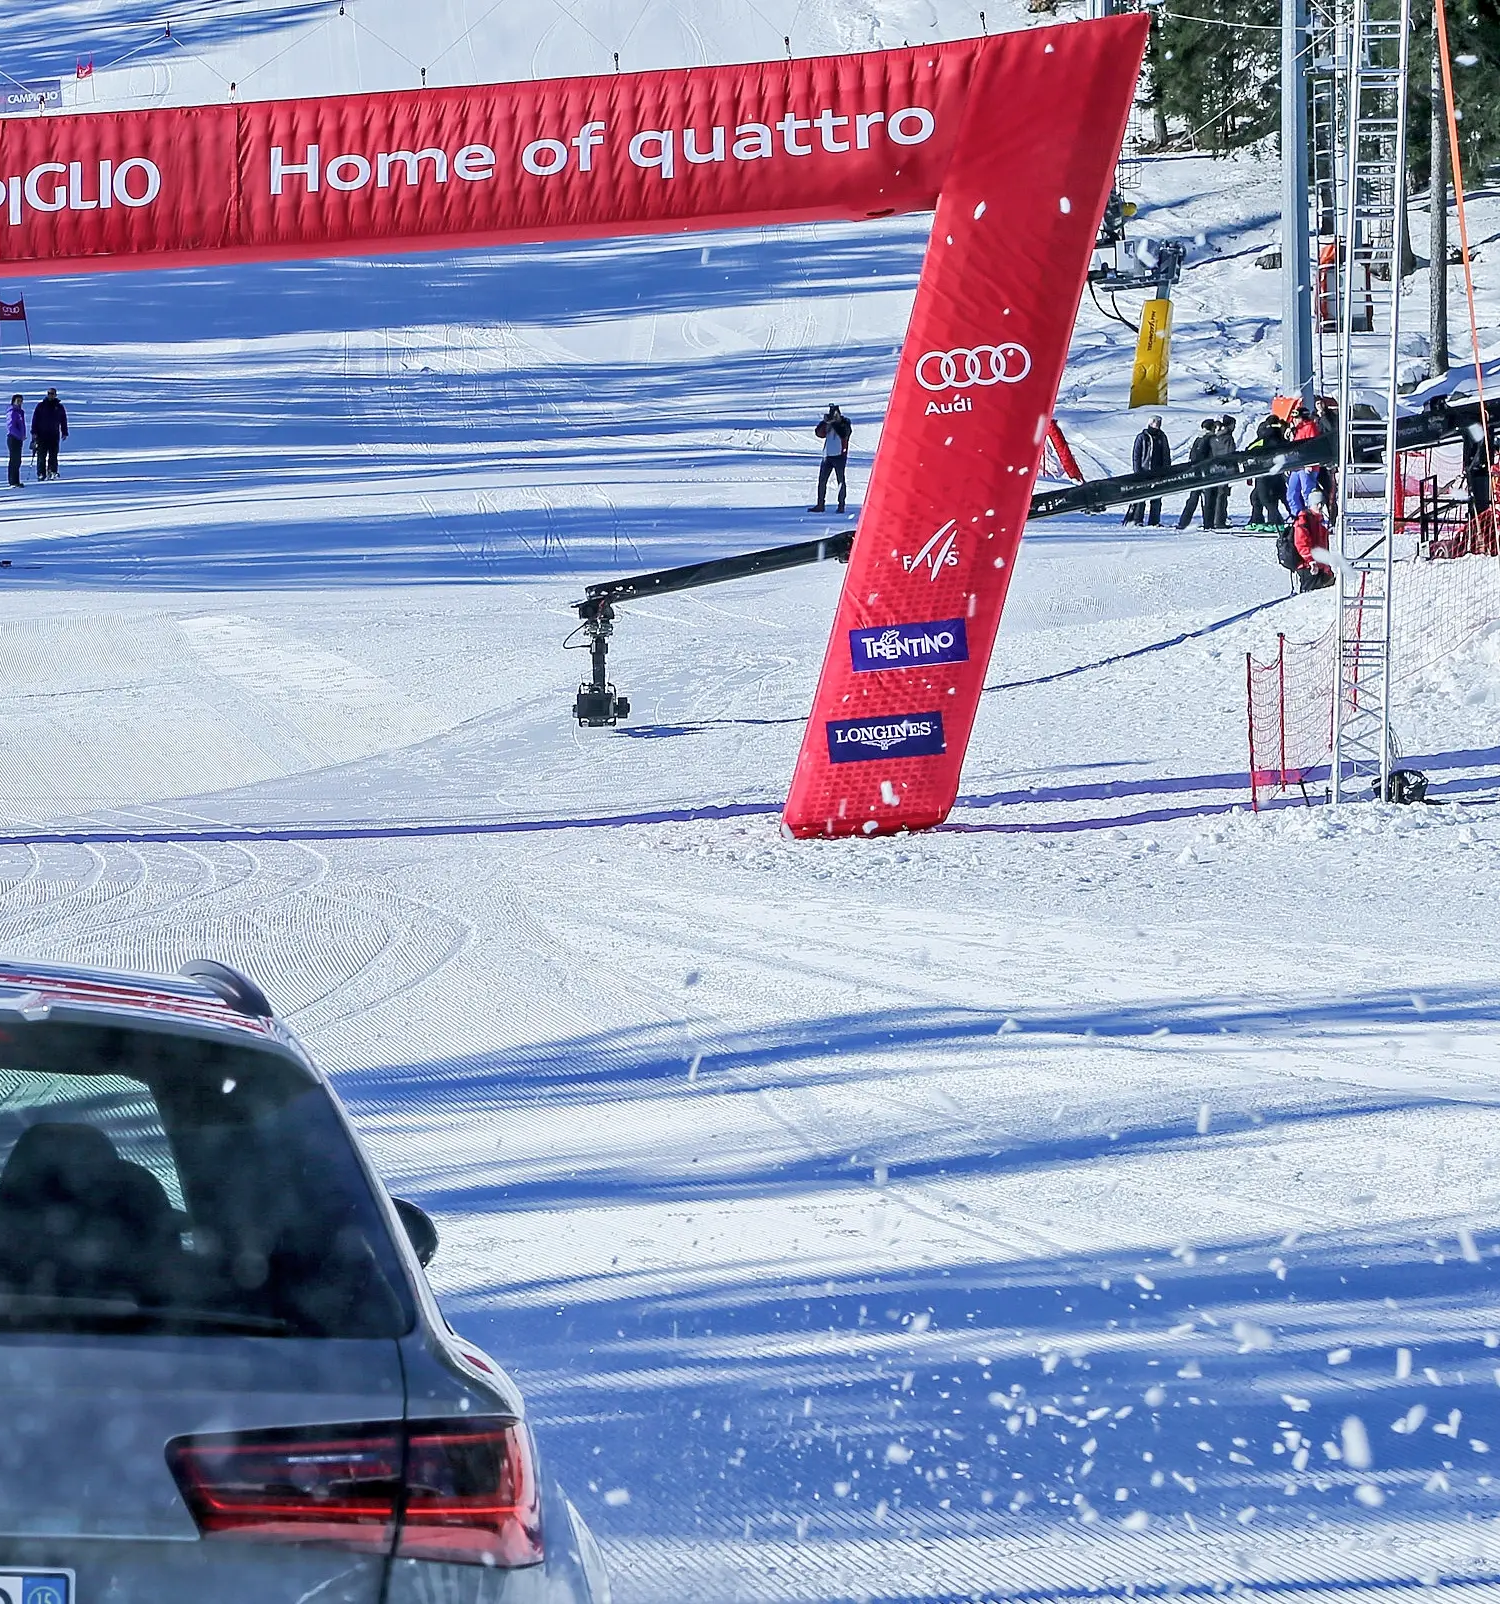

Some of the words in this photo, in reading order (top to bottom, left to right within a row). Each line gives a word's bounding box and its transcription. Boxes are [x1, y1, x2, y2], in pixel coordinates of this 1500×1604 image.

[269, 142, 496, 195] Home
[521, 120, 606, 176] of
[629, 106, 936, 180] quattro
[925, 398, 973, 417] Audi
[861, 632, 953, 660] TRENTINO
[835, 722, 932, 744] LONGINES
